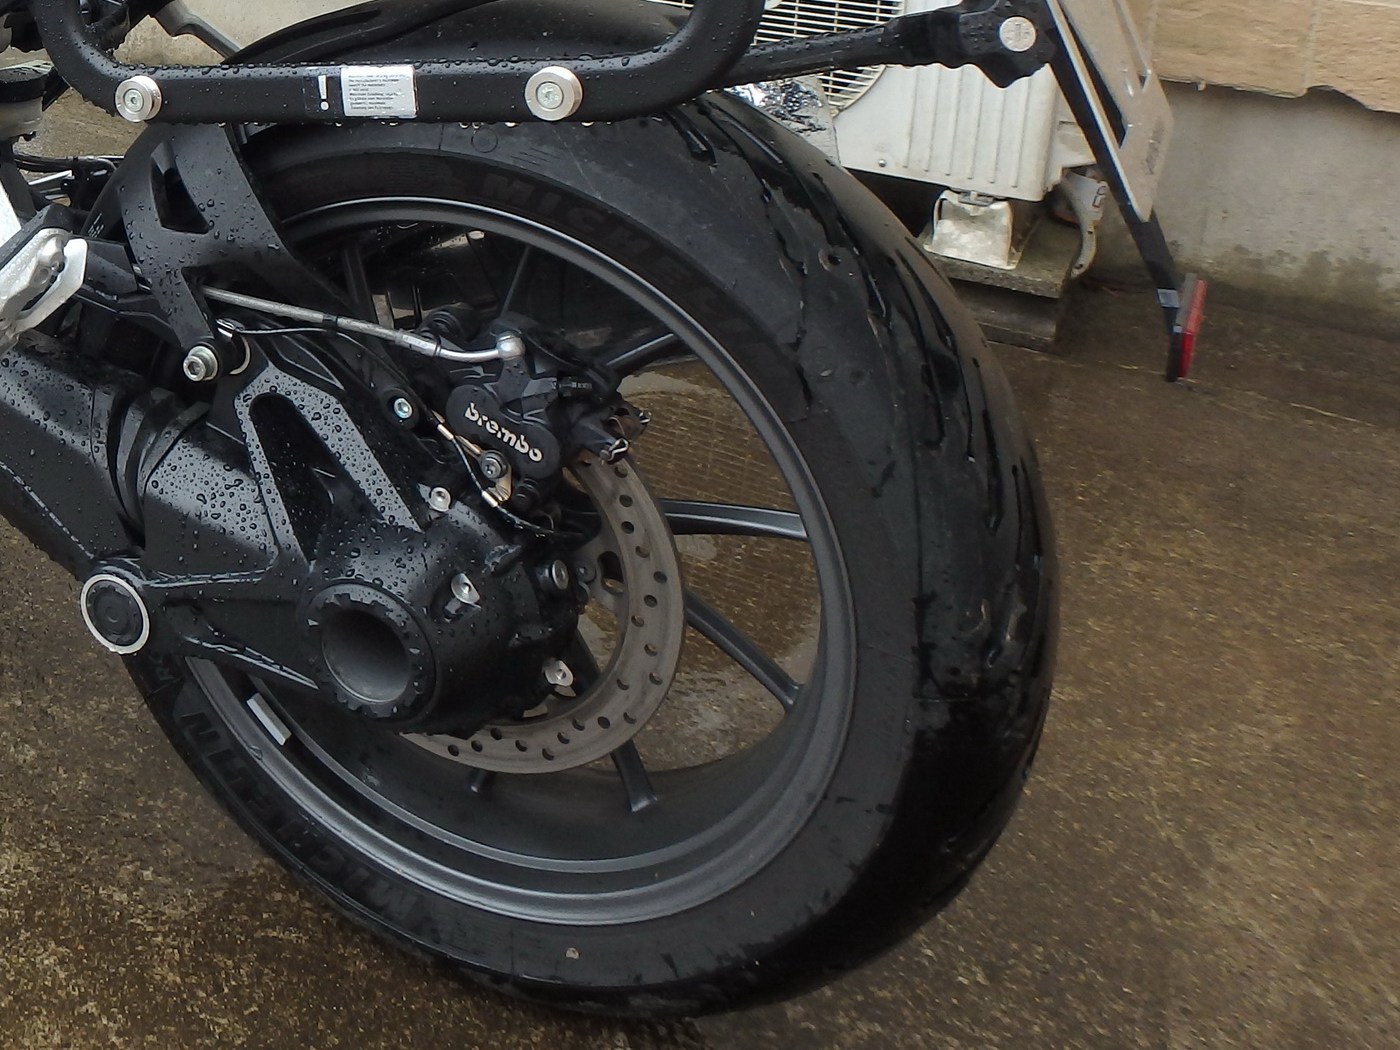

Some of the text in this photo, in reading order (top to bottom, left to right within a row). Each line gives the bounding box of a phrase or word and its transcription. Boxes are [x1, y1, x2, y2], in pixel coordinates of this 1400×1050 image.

[479, 172, 791, 382] MICHELIN
[464, 401, 543, 462] brembo
[177, 710, 420, 921] MICHELIN
